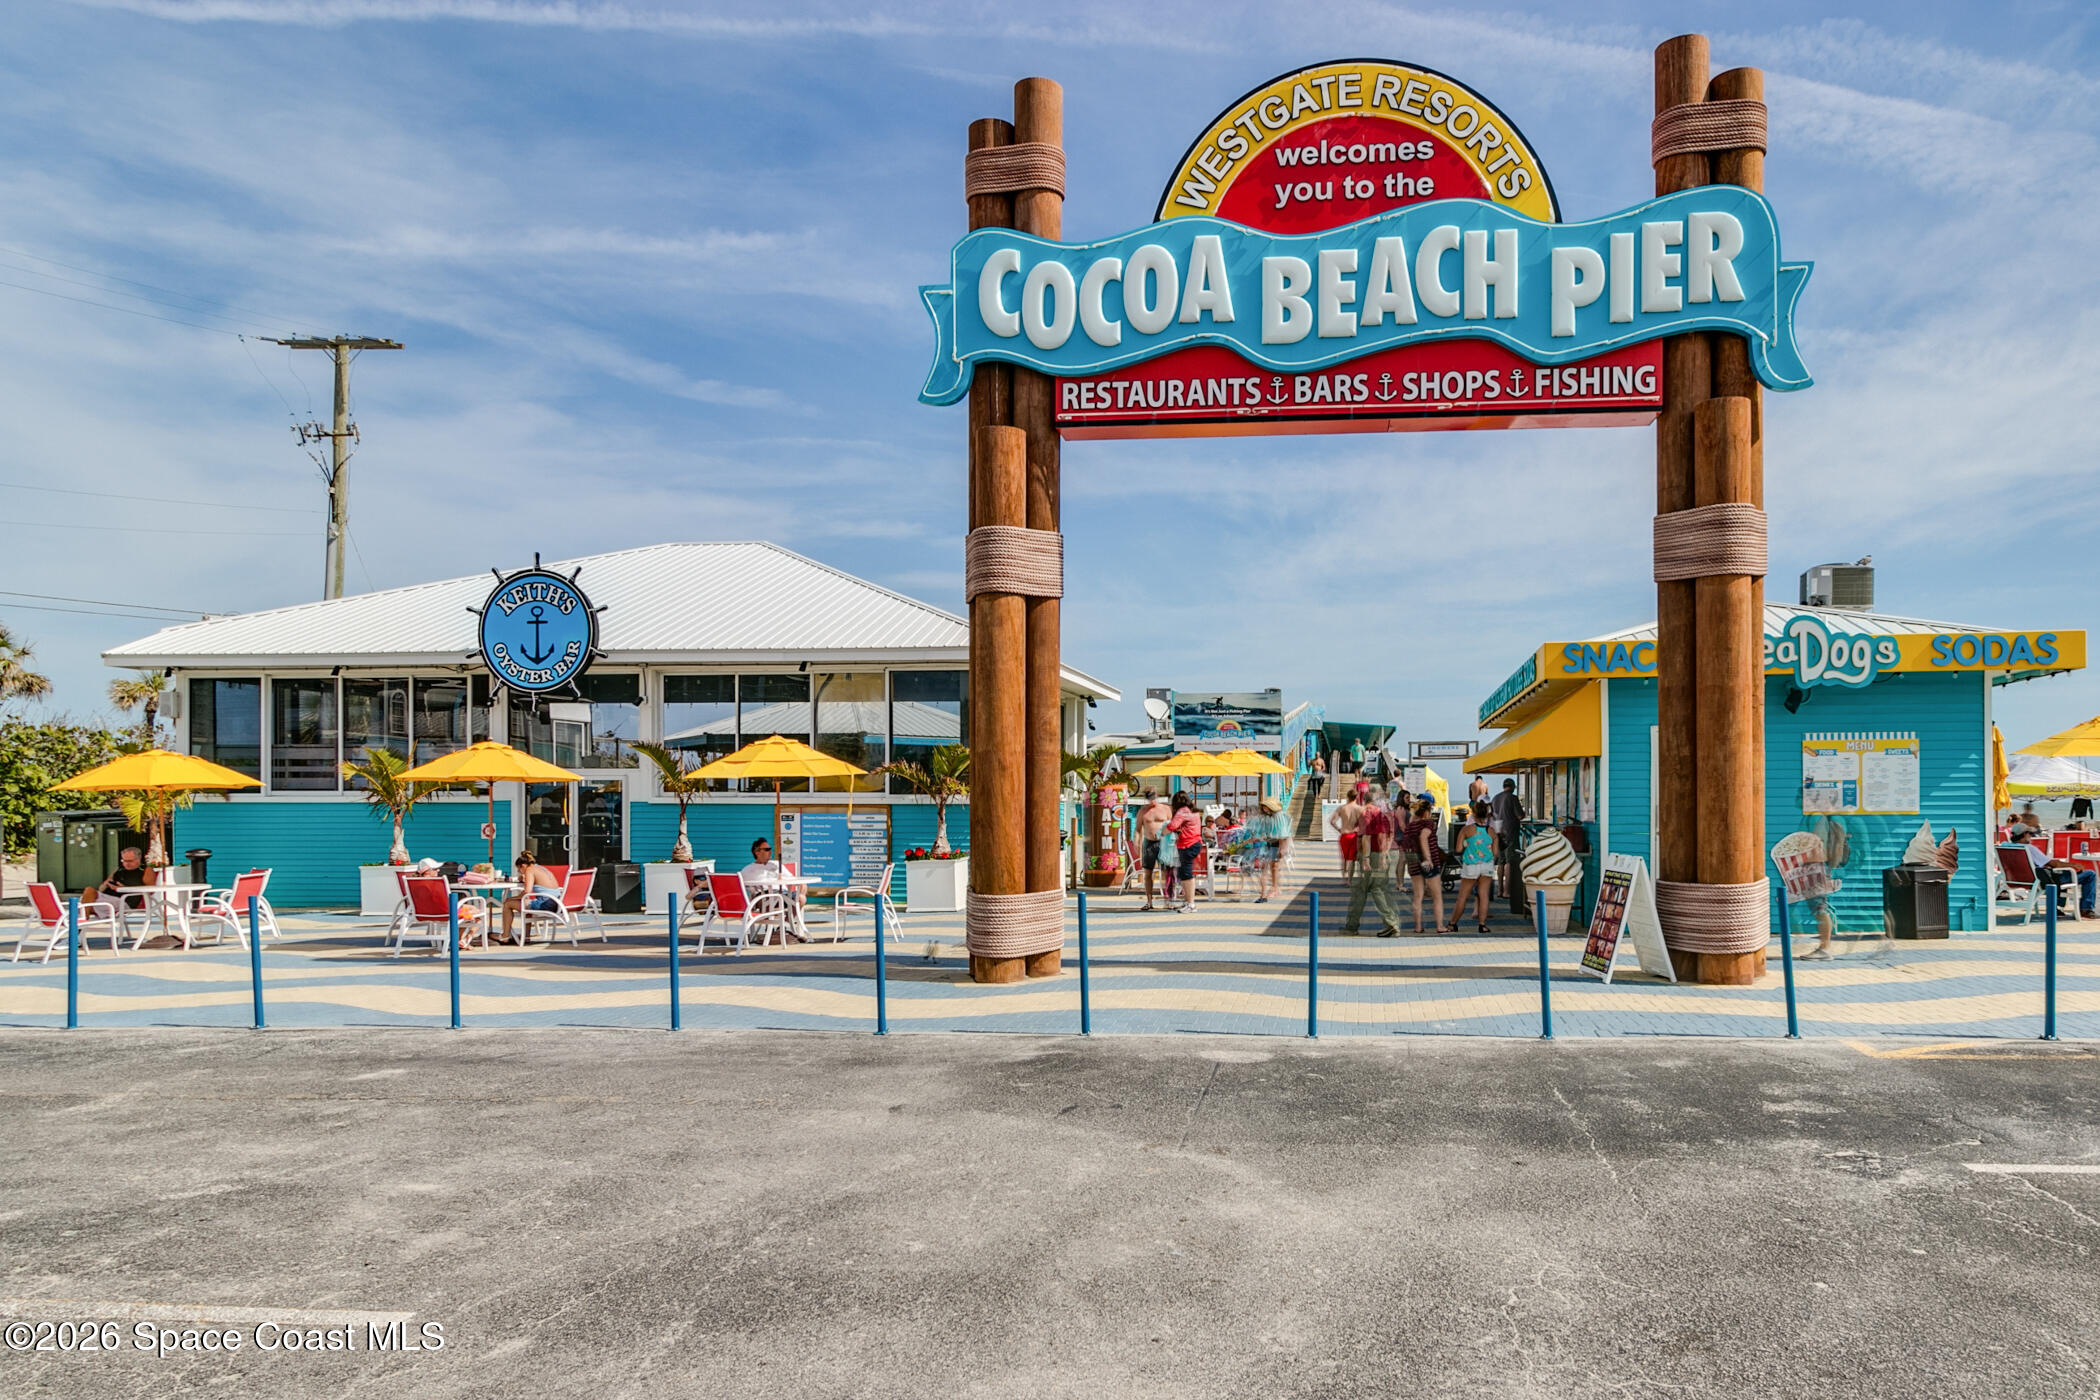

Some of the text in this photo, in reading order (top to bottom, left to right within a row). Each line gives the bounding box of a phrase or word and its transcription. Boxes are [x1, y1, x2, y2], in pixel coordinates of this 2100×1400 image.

[1175, 73, 1533, 209] WESTGATE RESORTS
[1274, 139, 1435, 167] welcomes
[1274, 172, 1435, 209] you to the
[978, 211, 1746, 350] COCOA BEACH PIER
[1061, 365, 1656, 410] RESTAURANTS BARS SHOPS FISHING
[496, 582, 578, 616] KEITH'S
[493, 641, 581, 683] OYSTER BAR
[1563, 641, 1657, 673] SNAC
[1763, 619, 1897, 684] eaDogs
[1932, 633, 2059, 666] SODAS
[1846, 741, 1875, 751] MENU
[1101, 808, 1113, 850] ATM
